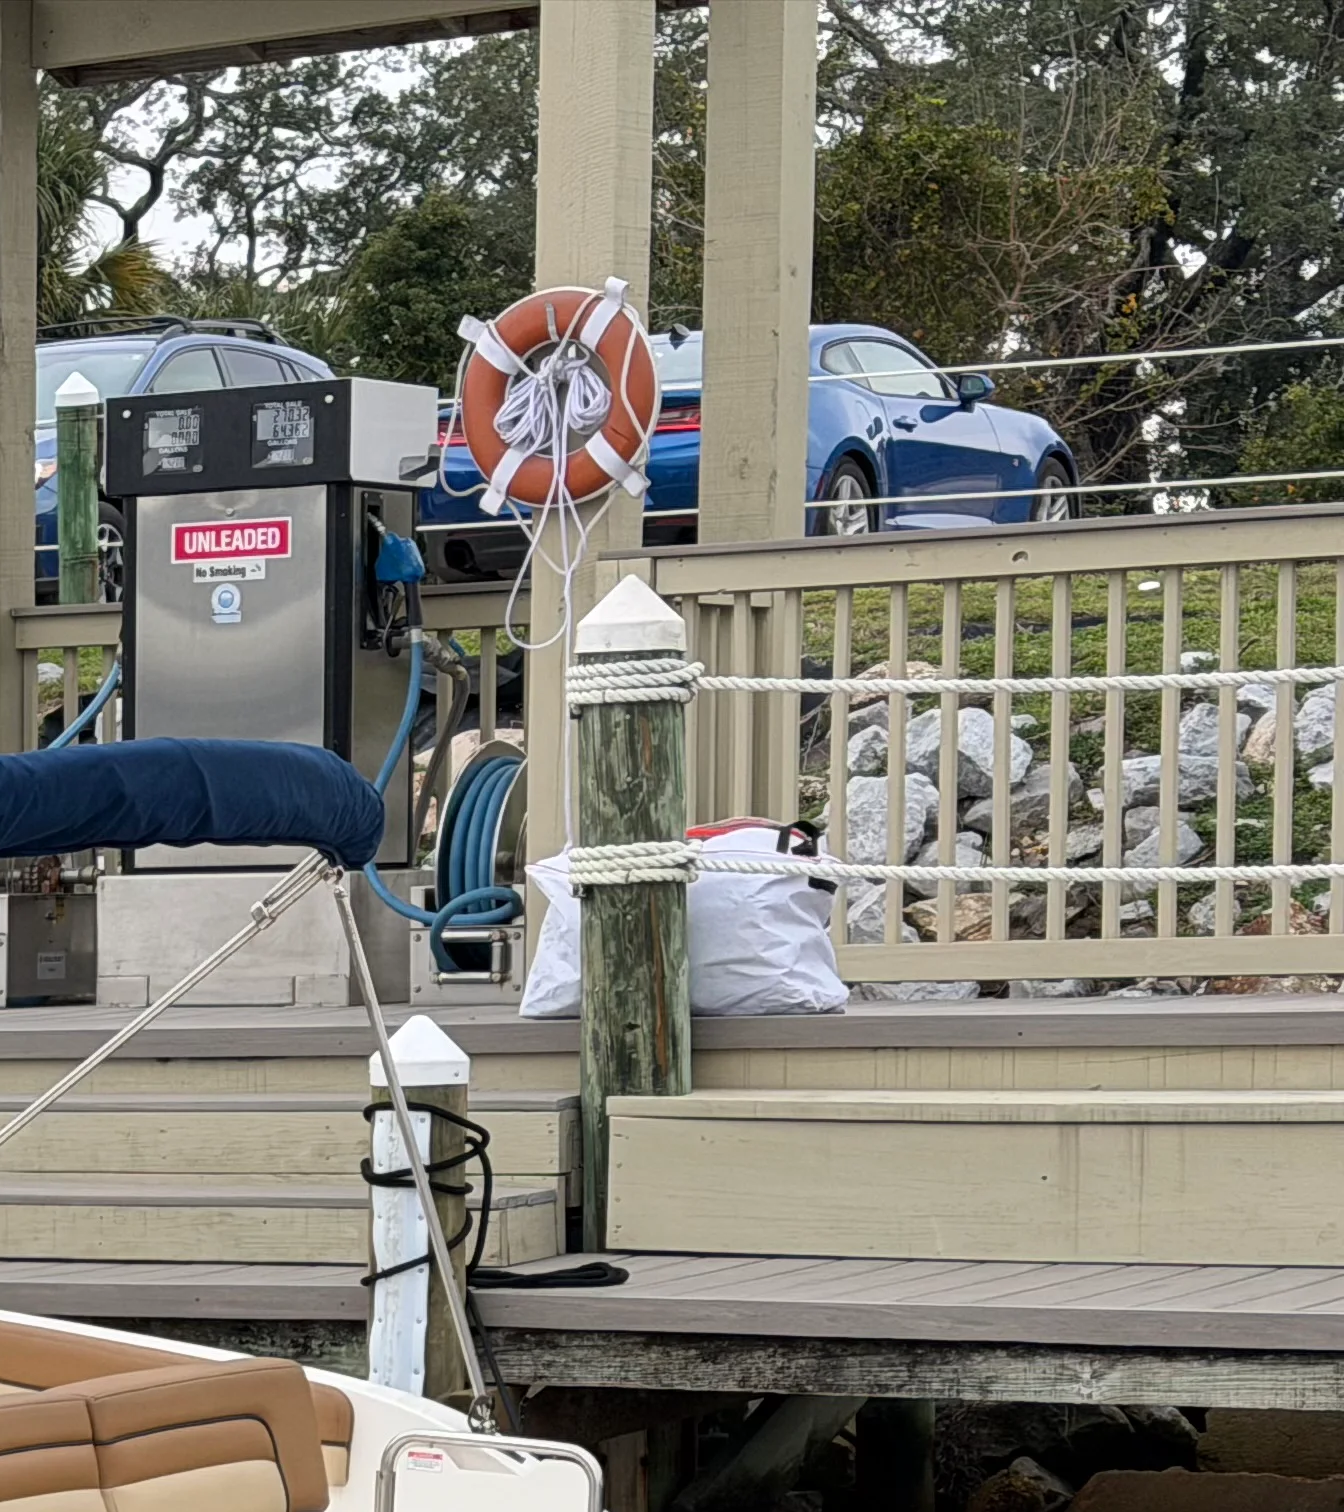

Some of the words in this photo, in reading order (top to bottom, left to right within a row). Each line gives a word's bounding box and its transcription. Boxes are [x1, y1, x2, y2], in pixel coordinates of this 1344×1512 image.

[184, 527, 281, 554] UNLEADED
[195, 567, 207, 578] No
[209, 565, 247, 579] Smoking
